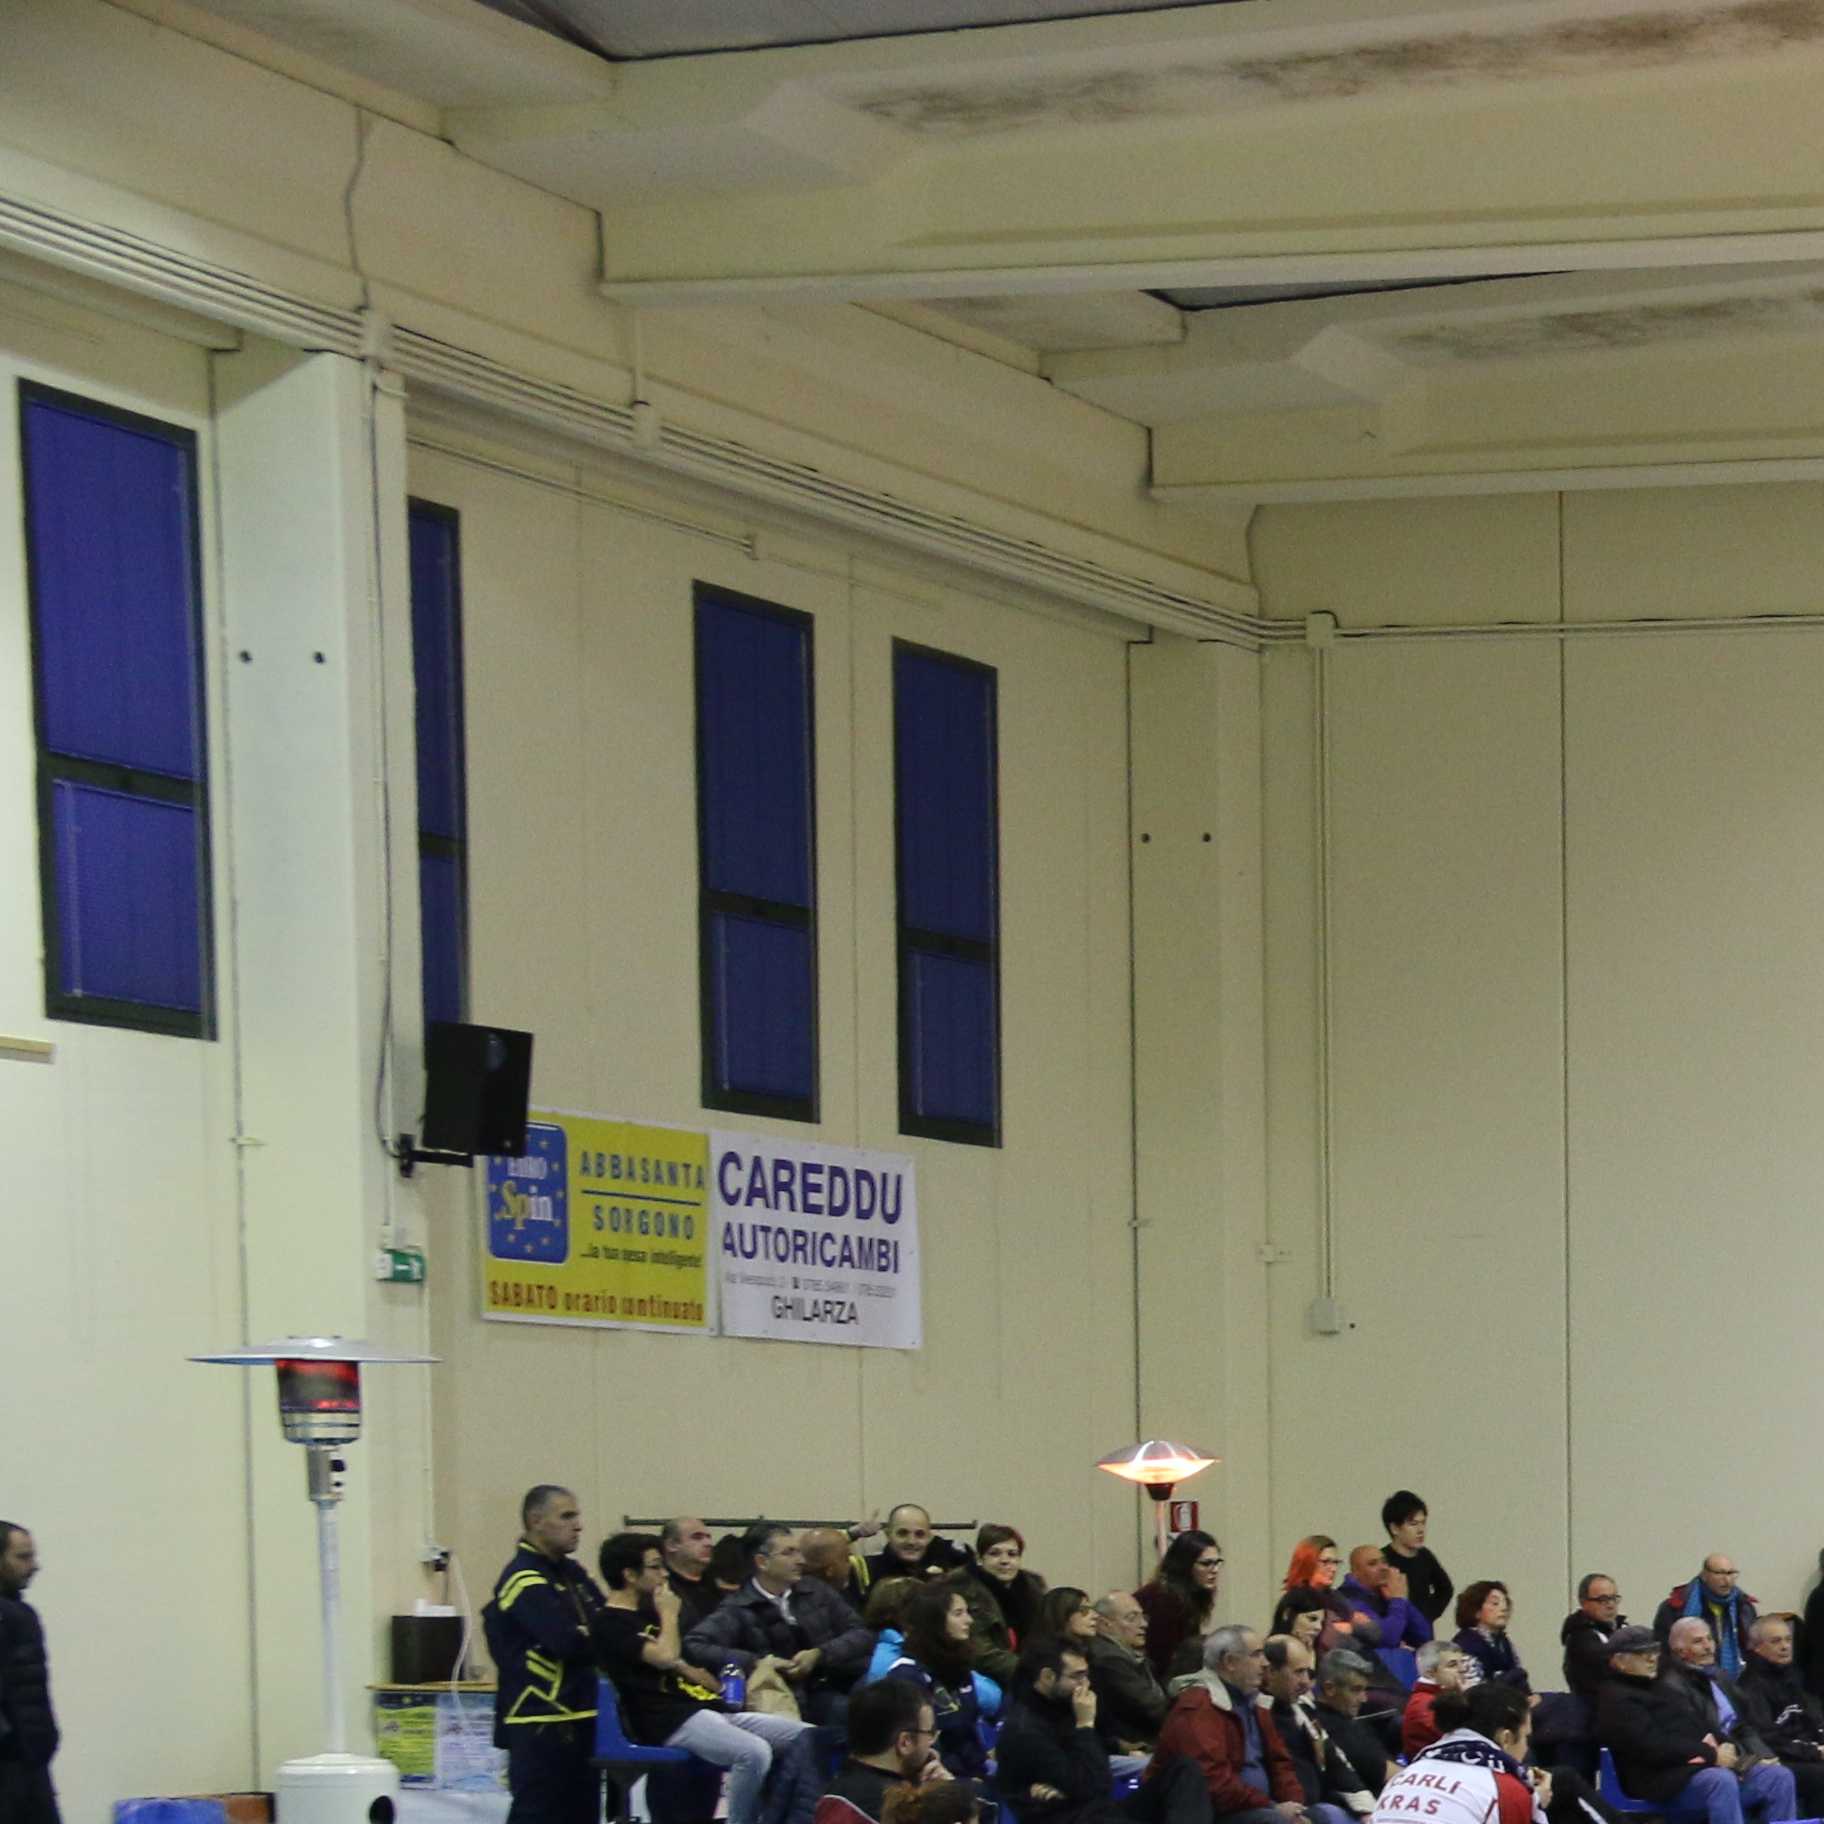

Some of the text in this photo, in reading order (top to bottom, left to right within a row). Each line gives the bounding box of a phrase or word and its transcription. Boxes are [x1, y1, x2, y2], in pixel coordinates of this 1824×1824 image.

[580, 1151, 704, 1189] ABBASANTA
[719, 1151, 902, 1224] CAREDDU
[593, 1205, 694, 1240] SORGONO
[723, 1222, 899, 1274] AUTORICAMBI
[490, 1280, 557, 1310] SABATO
[772, 1296, 858, 1325] GHILARZA
